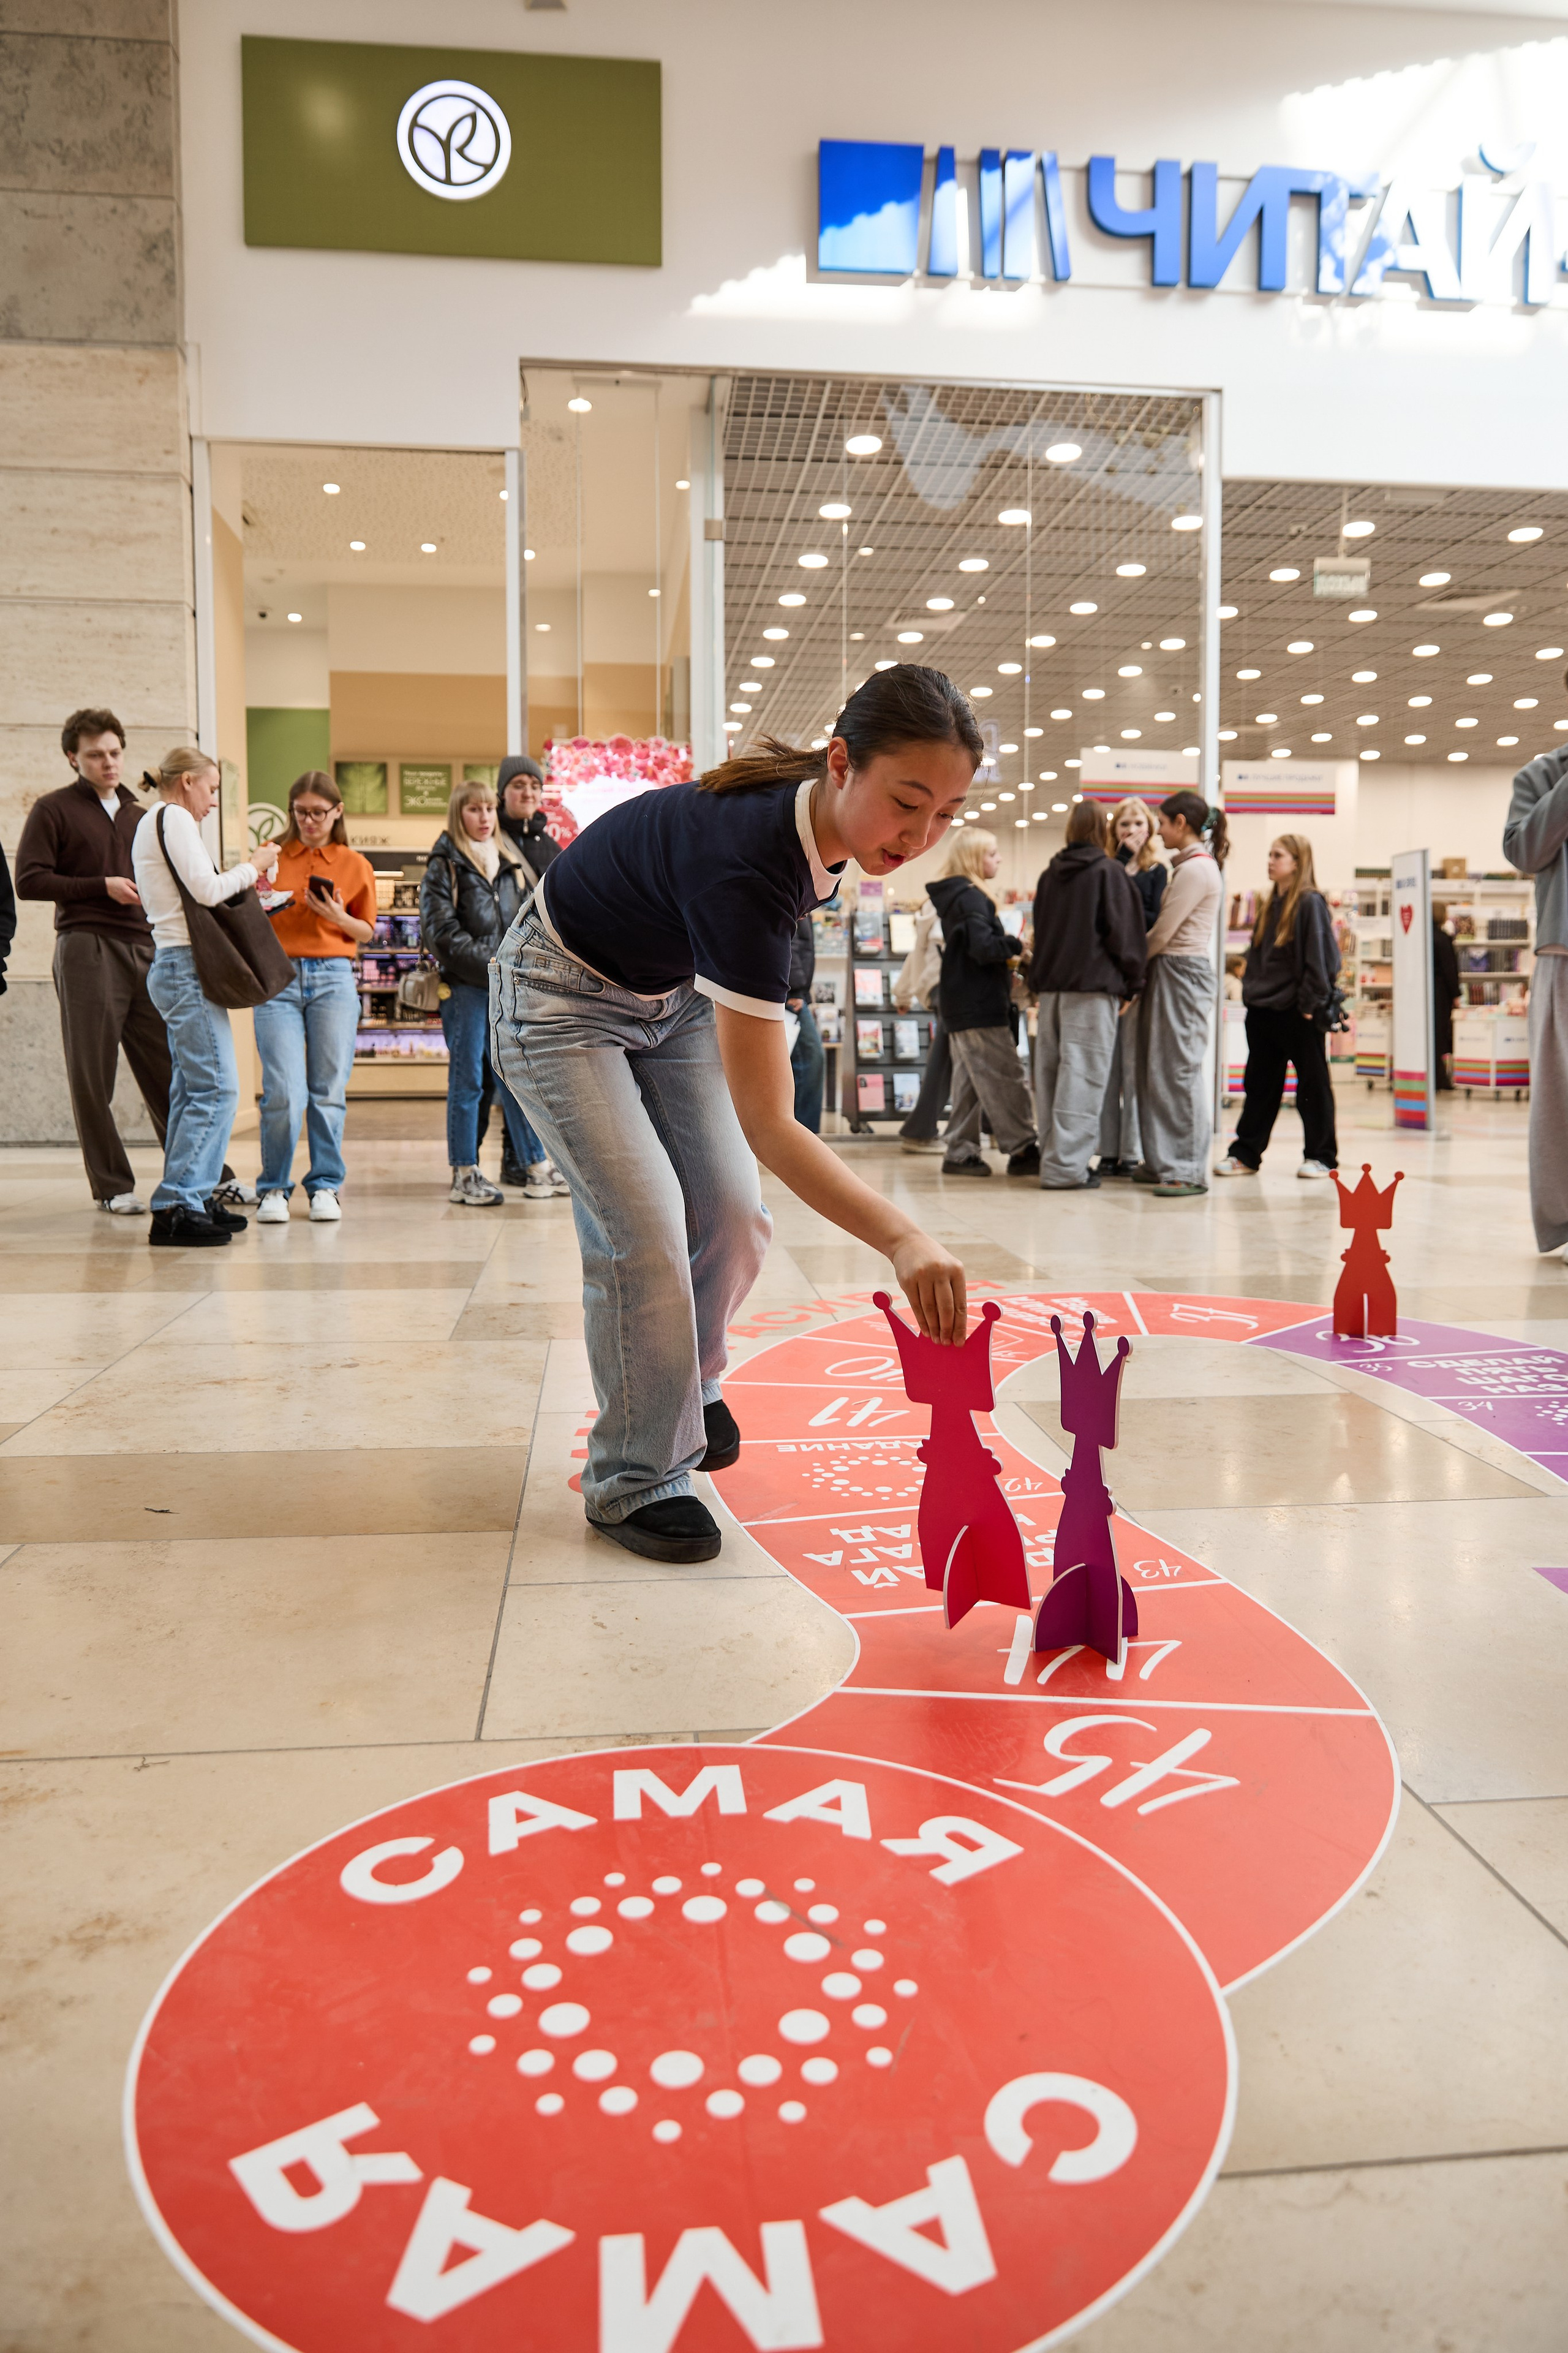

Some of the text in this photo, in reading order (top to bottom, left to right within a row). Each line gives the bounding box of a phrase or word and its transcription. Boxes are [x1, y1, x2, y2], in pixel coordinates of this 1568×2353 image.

[1087, 142, 1568, 304] ЧИТАЙ
[351, 836, 390, 845] КИЯЖ
[1359, 1362, 1393, 1372] 35
[1407, 1355, 1565, 1369] СДЕЛАЙ
[1455, 1365, 1559, 1376] ПЯТЬ
[1480, 1383, 1568, 1394] НАЗ
[809, 1397, 910, 1427] 41
[1458, 1401, 1493, 1411] 34
[776, 1440, 923, 1452] АДАНИЕ
[1004, 1476, 1044, 1492] 42
[802, 1543, 913, 1566] АГА
[1133, 1558, 1182, 1579] 43
[993, 1714, 1240, 1815] 45
[338, 1763, 1025, 1905] САМАЯ
